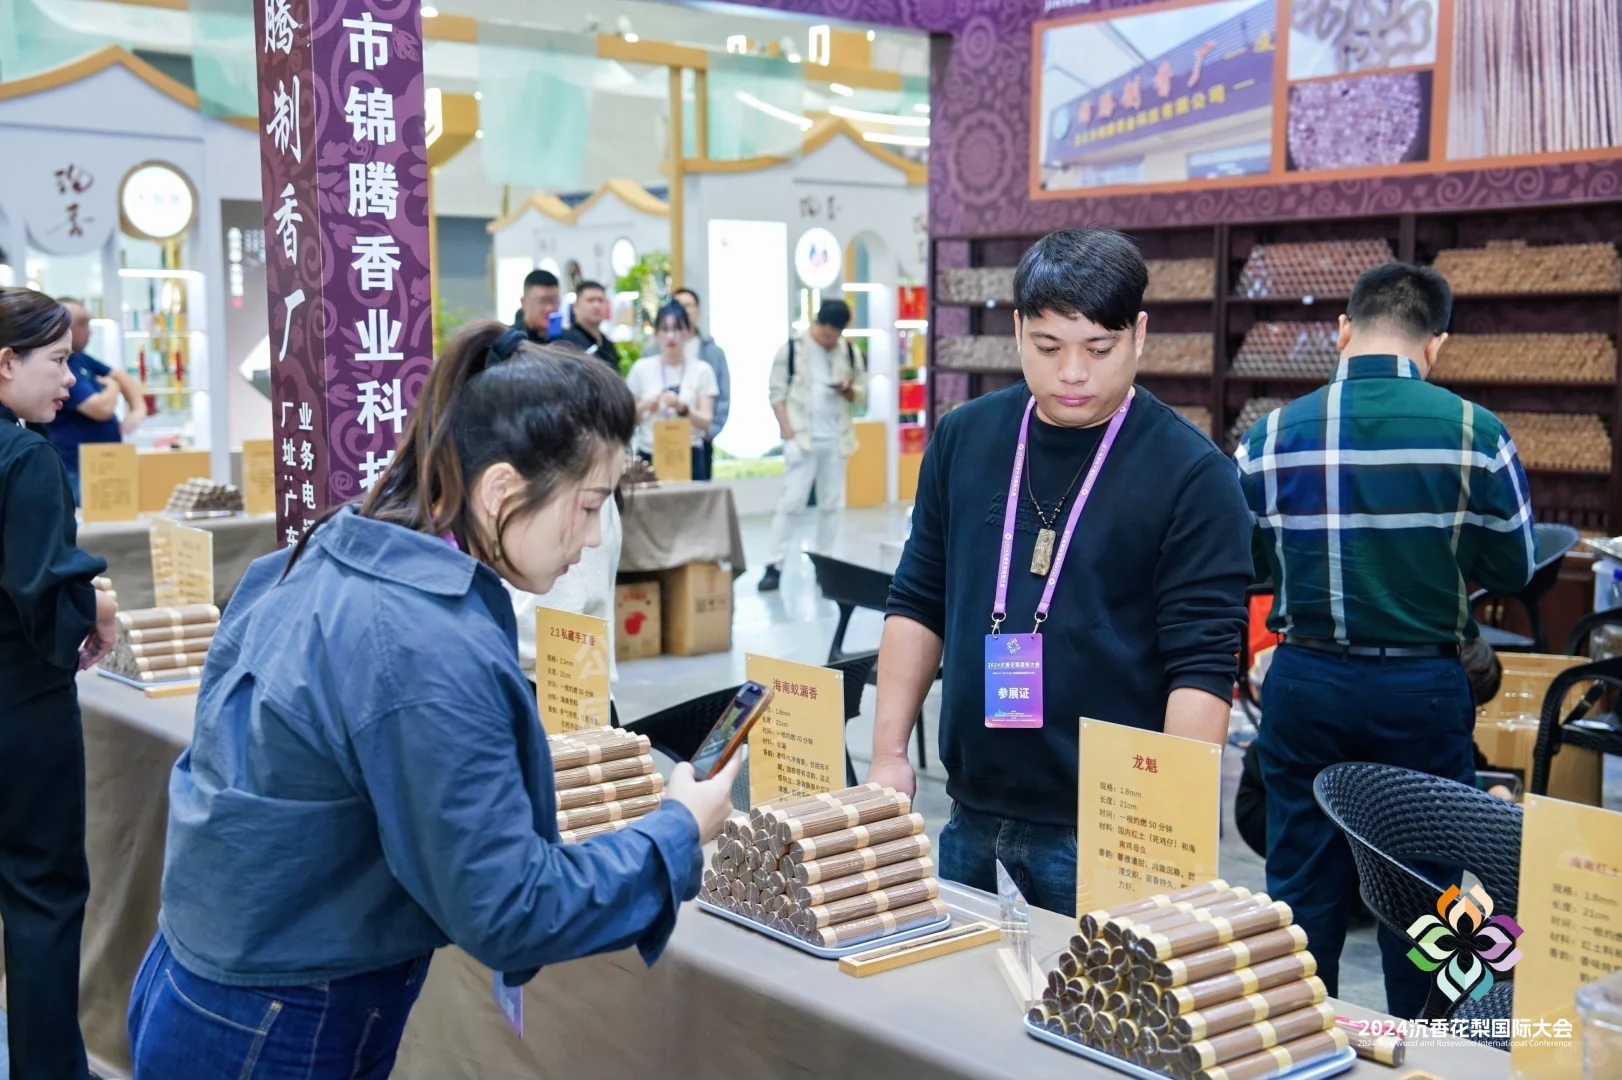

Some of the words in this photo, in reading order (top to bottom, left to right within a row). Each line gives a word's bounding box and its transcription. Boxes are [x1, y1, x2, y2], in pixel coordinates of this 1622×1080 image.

[264, 0, 306, 362] 腾制香厂
[772, 678, 818, 701] 海南蚁漏香
[997, 687, 1030, 700] 参展证
[1132, 754, 1158, 774] 龙魁
[1148, 820, 1157, 829] 50
[1158, 822, 1173, 834] 分钟
